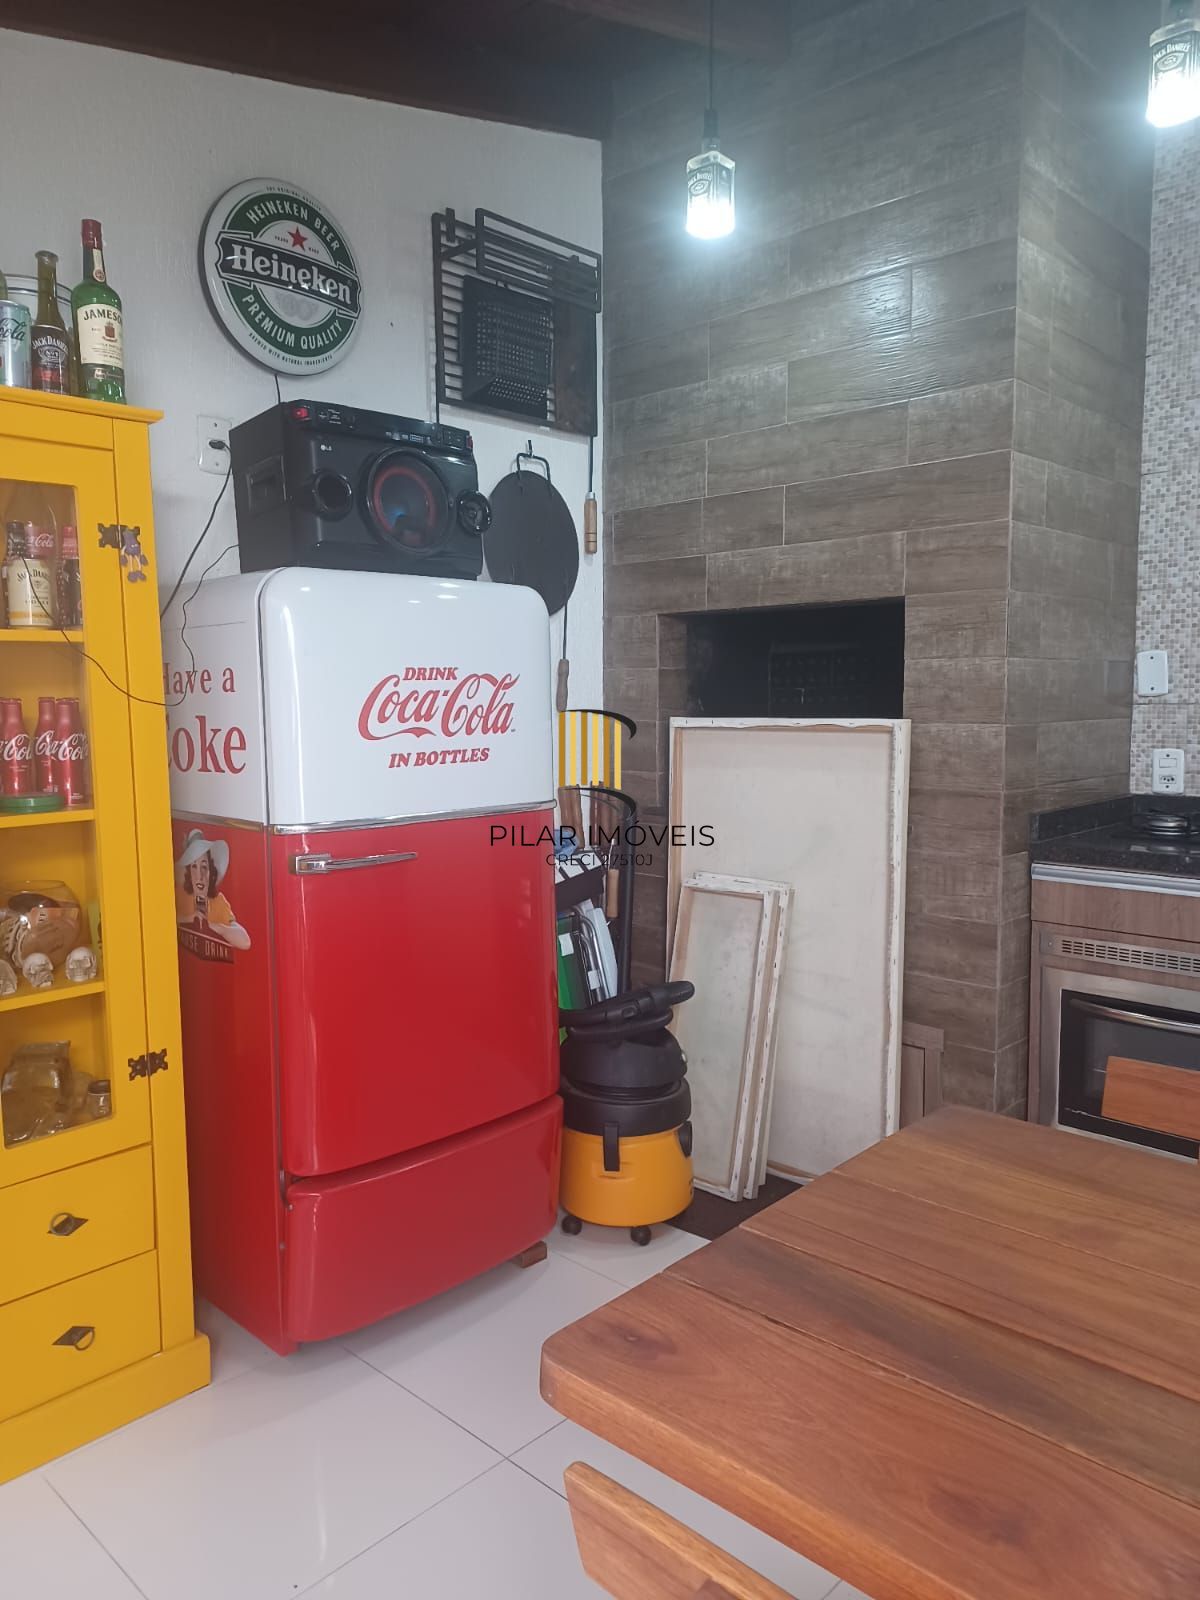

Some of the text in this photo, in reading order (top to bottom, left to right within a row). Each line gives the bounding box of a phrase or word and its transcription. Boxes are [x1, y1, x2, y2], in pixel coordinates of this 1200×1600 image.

[246, 199, 340, 251] HEINEKEN BEER
[231, 244, 352, 304] Heineken
[242, 294, 342, 350] PREMIUM QUALITY
[222, 667, 236, 693] a
[402, 666, 458, 681] DRINK
[358, 673, 520, 741] Coca-Cola
[166, 712, 247, 775] oke
[388, 747, 490, 768] IN BOTTLES
